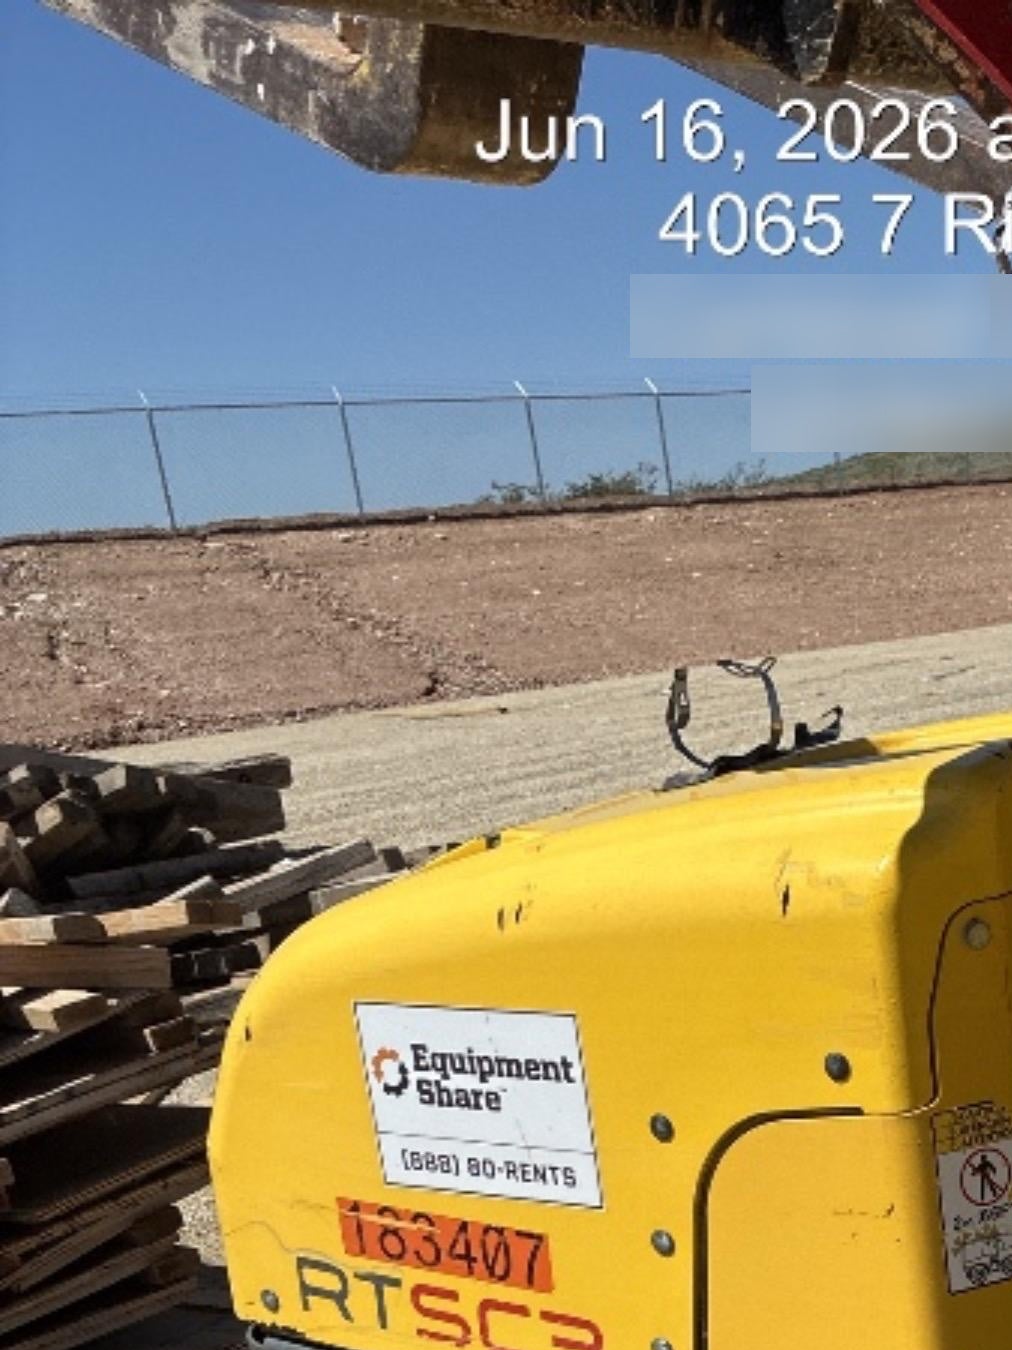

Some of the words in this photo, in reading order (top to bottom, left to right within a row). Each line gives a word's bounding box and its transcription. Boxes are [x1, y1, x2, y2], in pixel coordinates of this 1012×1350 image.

[410, 1044, 576, 1084] Equipment
[416, 1080, 502, 1111] Share
[401, 1148, 459, 1177] (888)
[467, 1157, 577, 1188] 80-RENTS
[346, 1200, 545, 1288] 183407
